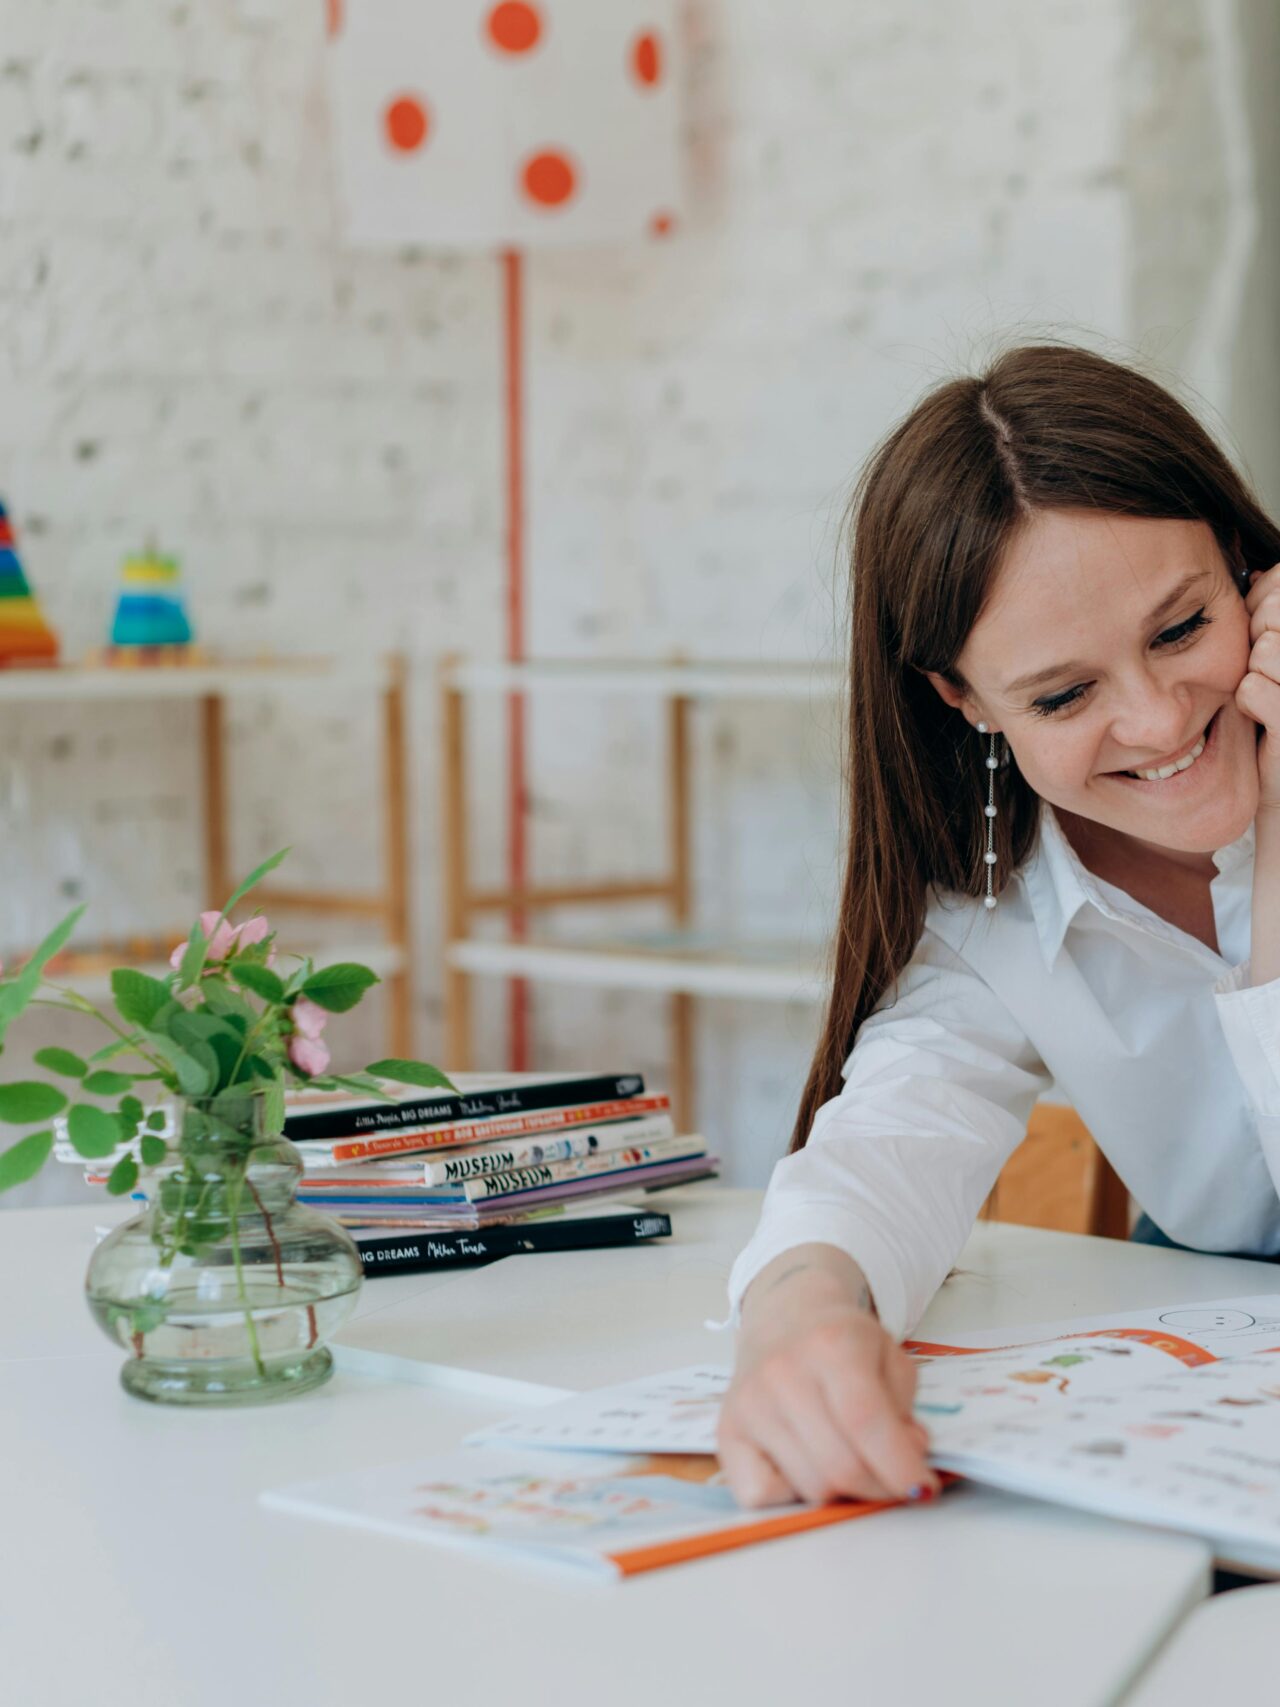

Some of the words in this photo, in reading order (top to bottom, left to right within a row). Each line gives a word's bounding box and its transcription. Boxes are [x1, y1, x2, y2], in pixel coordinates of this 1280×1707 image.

[401, 1106, 416, 1121] BIG
[418, 1103, 453, 1119] DREAMS
[445, 1152, 514, 1180] MUSEUM
[484, 1166, 552, 1195] MUSEUM
[377, 1246, 420, 1261] DREAMS
